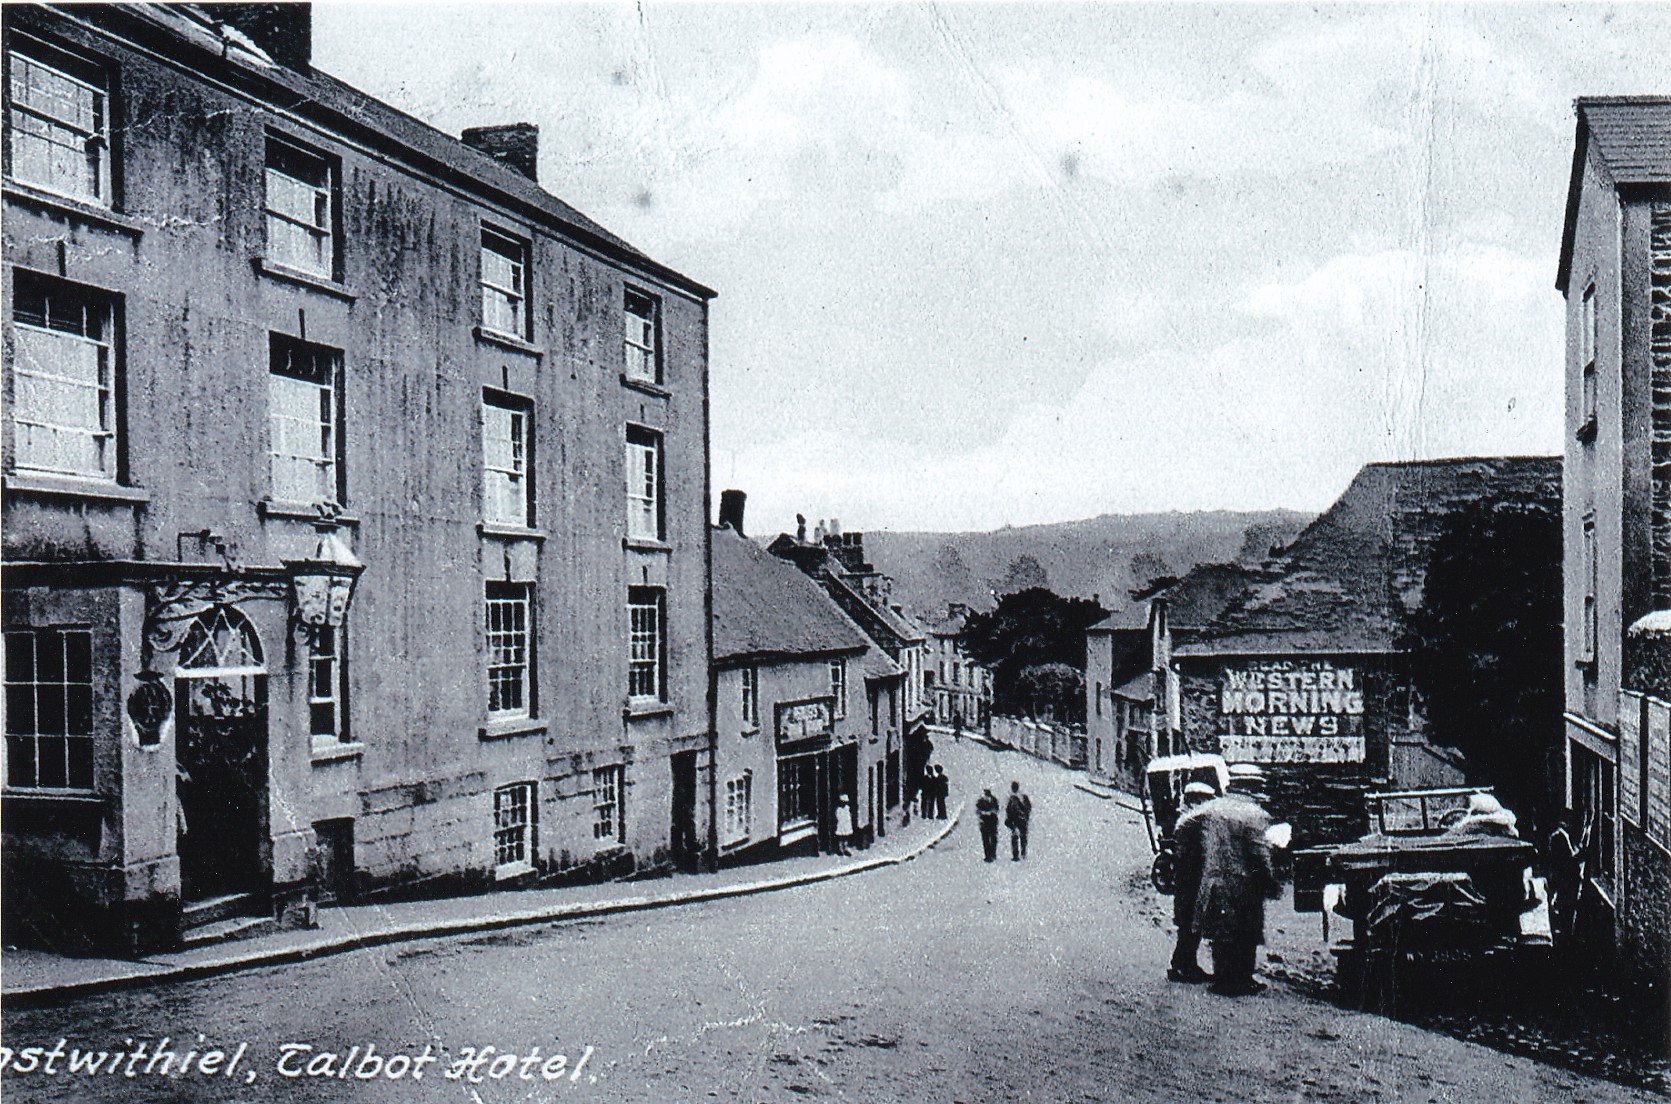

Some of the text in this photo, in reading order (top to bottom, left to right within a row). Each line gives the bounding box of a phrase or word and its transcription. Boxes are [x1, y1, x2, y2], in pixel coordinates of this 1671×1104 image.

[1225, 667, 1354, 691] WESTERN
[1222, 690, 1365, 714] MORNING
[1244, 715, 1339, 736] NEWS
